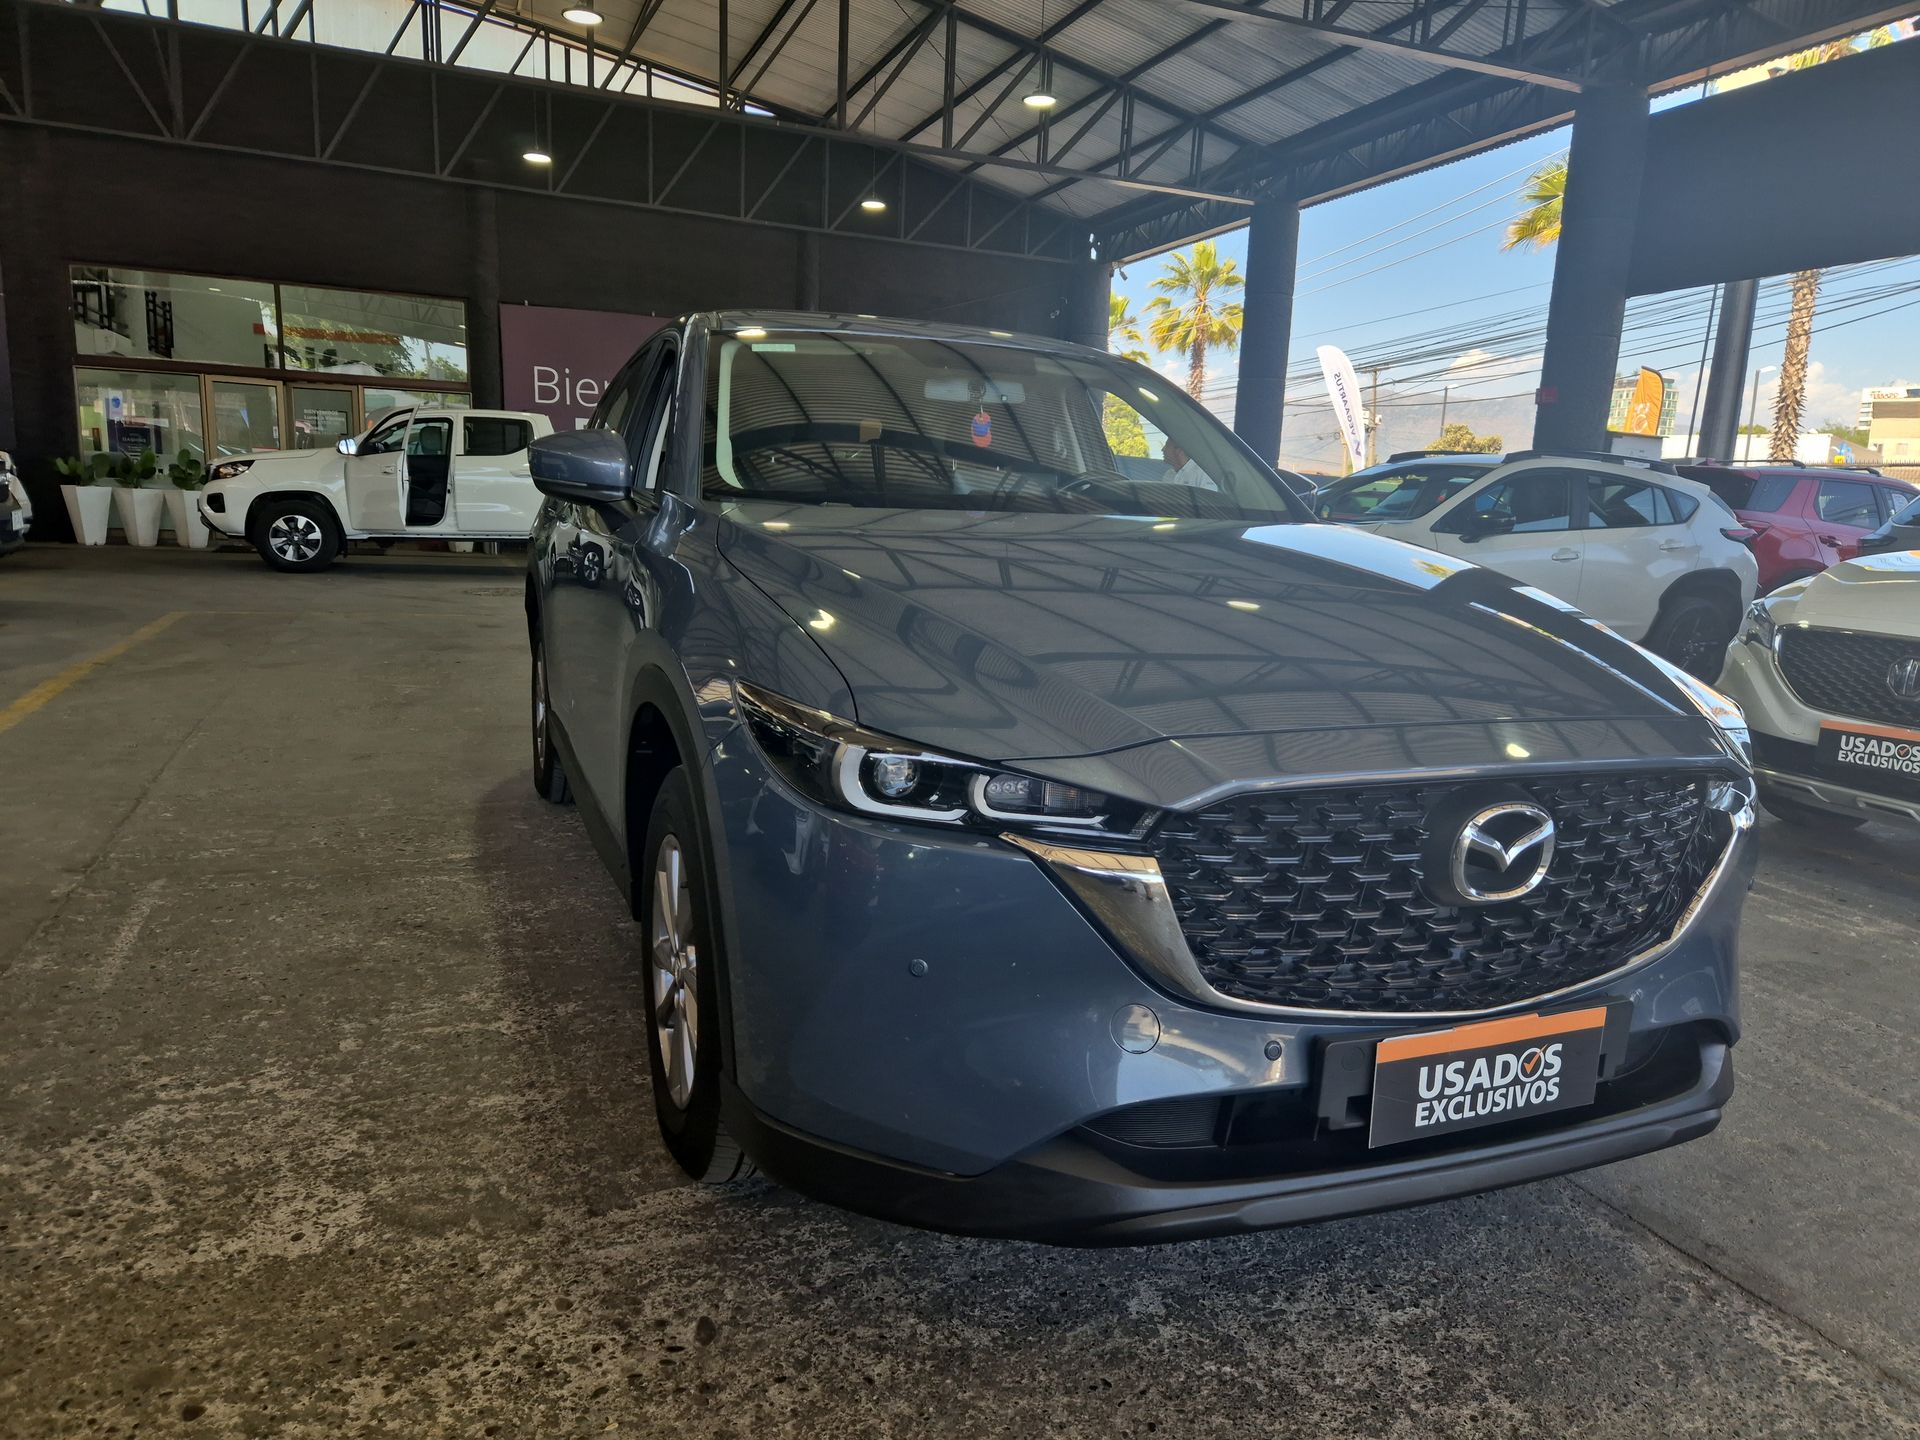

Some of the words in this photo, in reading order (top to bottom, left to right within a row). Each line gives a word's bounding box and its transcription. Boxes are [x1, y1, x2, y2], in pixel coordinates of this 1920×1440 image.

[533, 365, 612, 408] Bie
[1837, 749, 1920, 775] EXCLUSIVOS
[1840, 734, 1920, 762] USADOS
[1418, 1042, 1563, 1100] USADOS
[1414, 1076, 1560, 1128] EXCLUSIVOS
